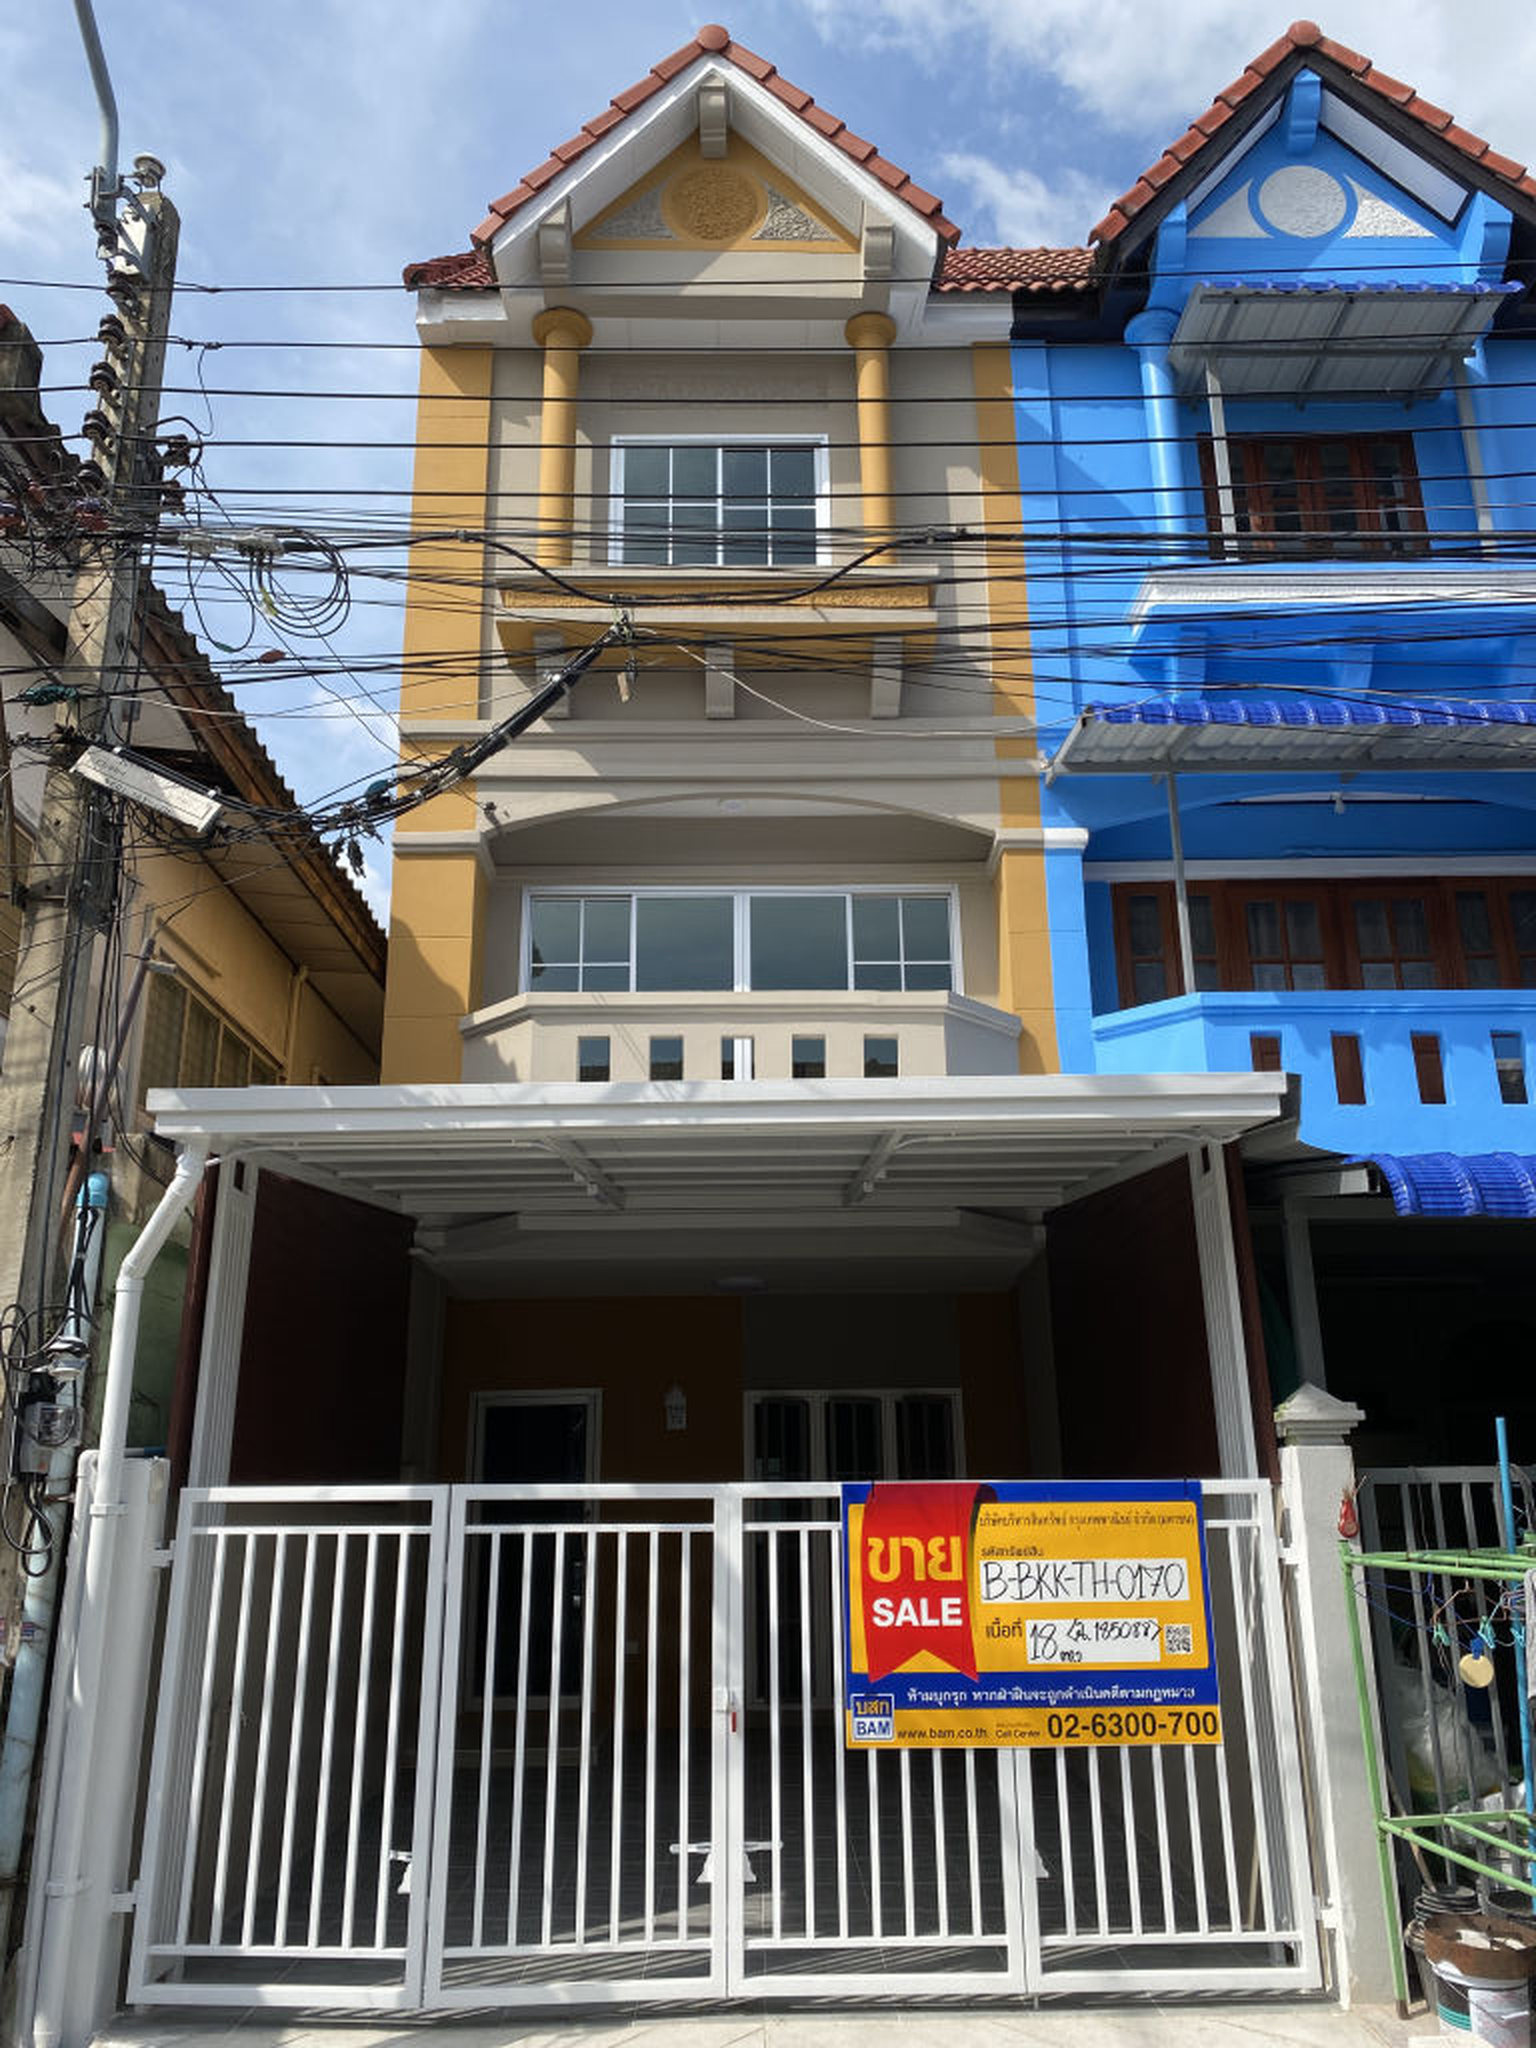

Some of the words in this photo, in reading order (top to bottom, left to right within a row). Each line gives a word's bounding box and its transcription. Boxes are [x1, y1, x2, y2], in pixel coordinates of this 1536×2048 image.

[868, 1536, 962, 1583] ขาย
[983, 1561, 1185, 1600] B-BKK-TH-0170
[872, 1597, 962, 1627] SALE
[985, 1616, 1023, 1639] เนื้อที่
[1029, 1623, 1058, 1661] 18
[855, 1699, 890, 1715] บสก
[907, 1687, 967, 1707] ห้ามบุกรุก
[856, 1721, 890, 1736] BAM
[897, 1728, 987, 1740] www.bam.co.th
[1047, 1711, 1218, 1739] 02-6300-700
